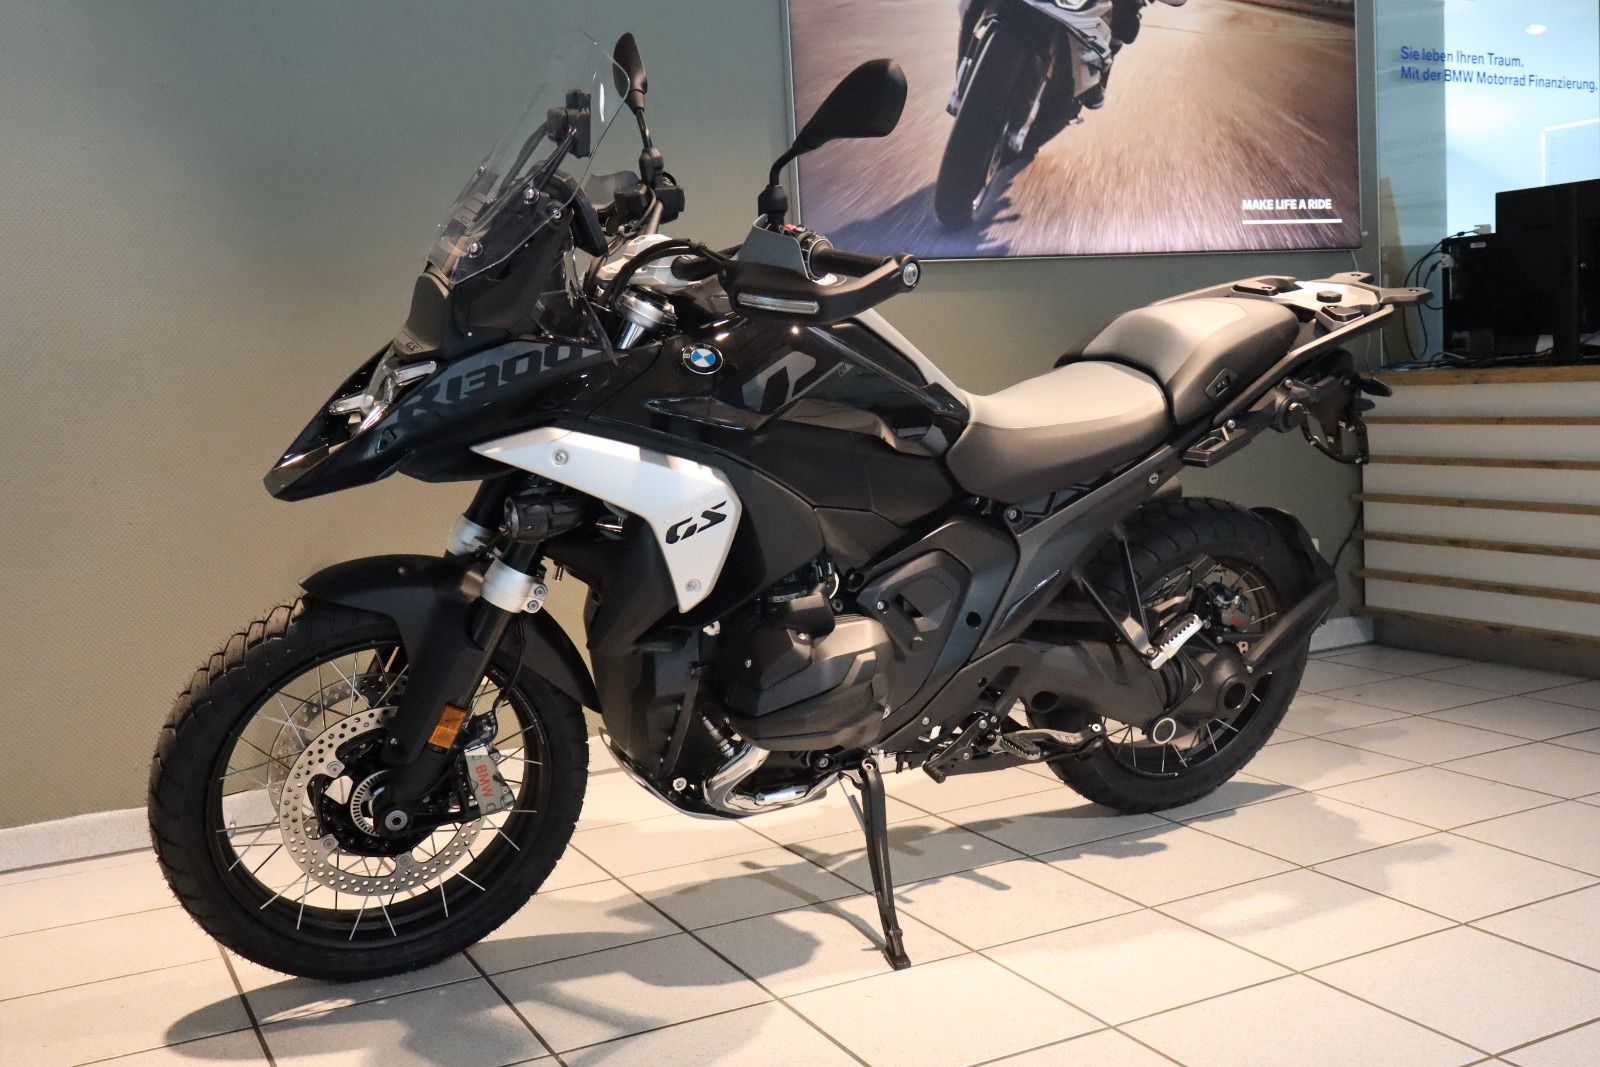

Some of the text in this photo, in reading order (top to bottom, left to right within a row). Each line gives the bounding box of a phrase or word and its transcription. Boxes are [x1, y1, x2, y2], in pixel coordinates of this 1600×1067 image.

[1401, 46, 1524, 67] Sie leben Ihren Traum.
[1401, 66, 1598, 93] Mit der BMW Motorrad Finanzierung.
[1242, 199, 1333, 210] MAKE LIFE A RIDE
[665, 500, 728, 544] GS
[475, 764, 494, 797] BMW
